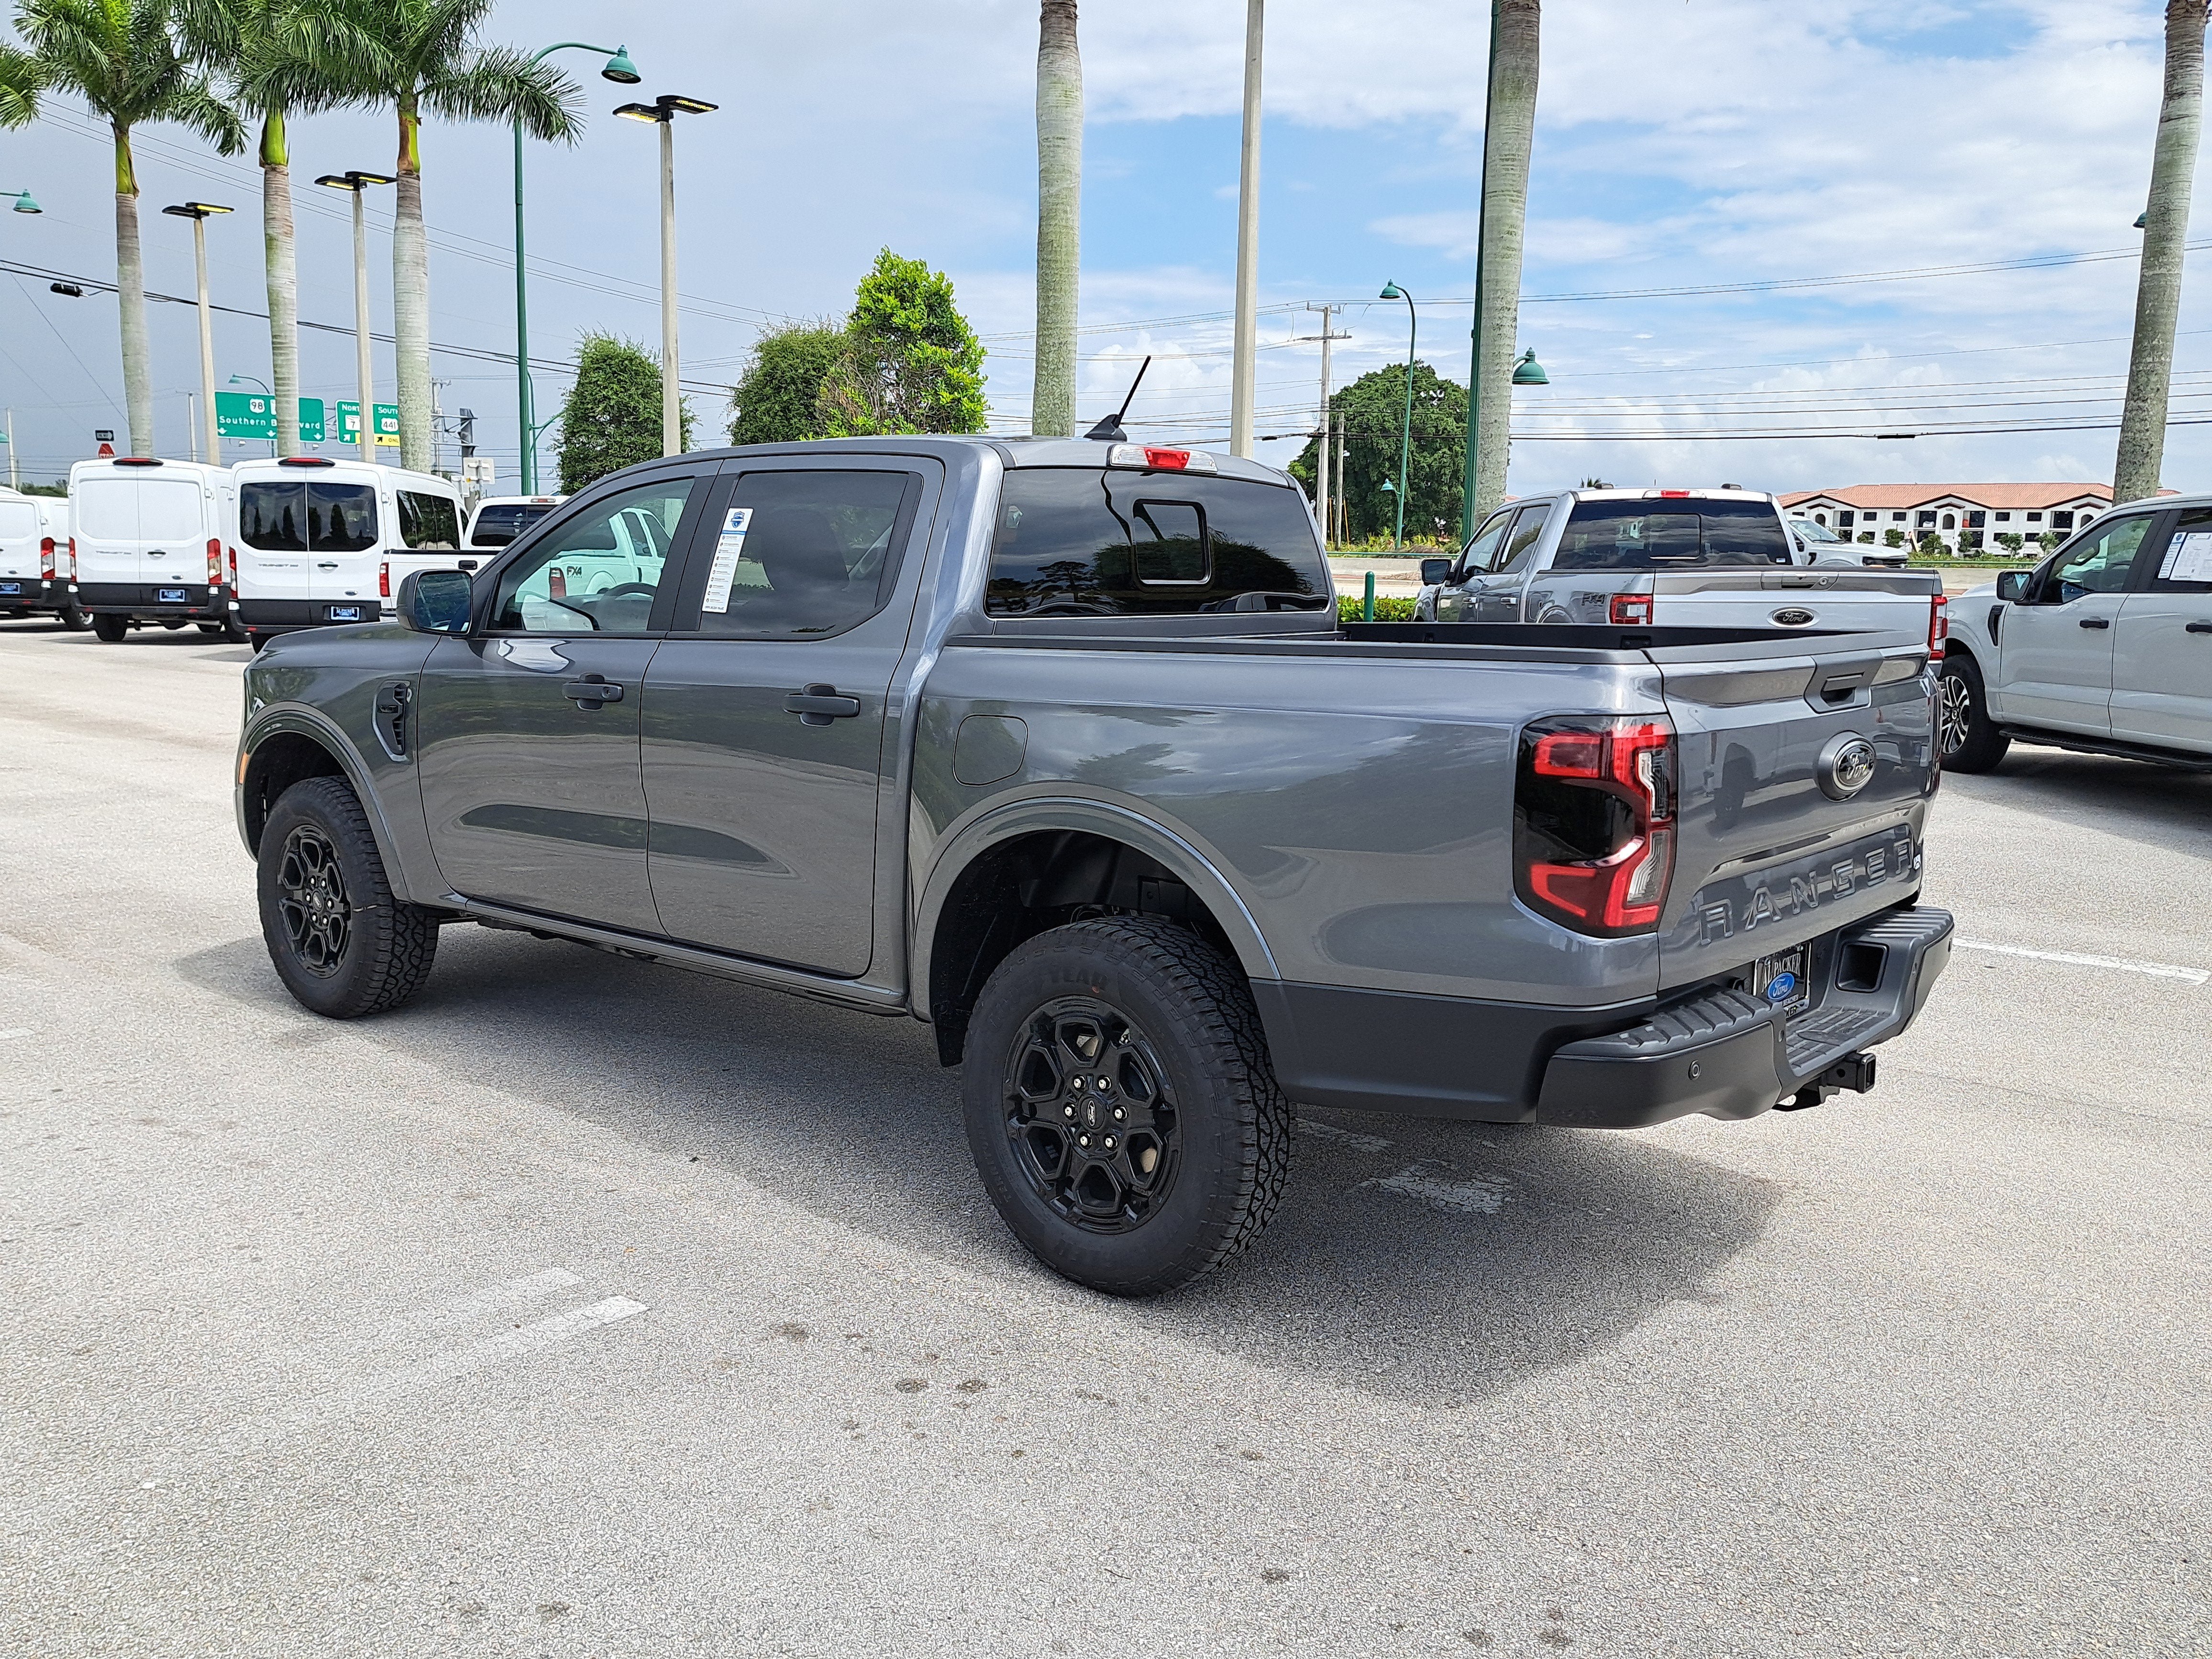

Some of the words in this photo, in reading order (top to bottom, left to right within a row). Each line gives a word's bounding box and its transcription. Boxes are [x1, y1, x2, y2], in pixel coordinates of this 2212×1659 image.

[251, 401, 263, 410] 98
[342, 404, 360, 412] NORT
[219, 415, 266, 426] Southern
[383, 421, 396, 430] 441
[567, 565, 582, 576] FX4
[1581, 593, 1605, 606] FX4
[1782, 612, 1805, 622] Ford
[1846, 751, 1870, 780] Ford
[1698, 838, 1913, 946] RANGER
[1773, 952, 1802, 977] PACKER
[1772, 978, 1790, 997] Ford
